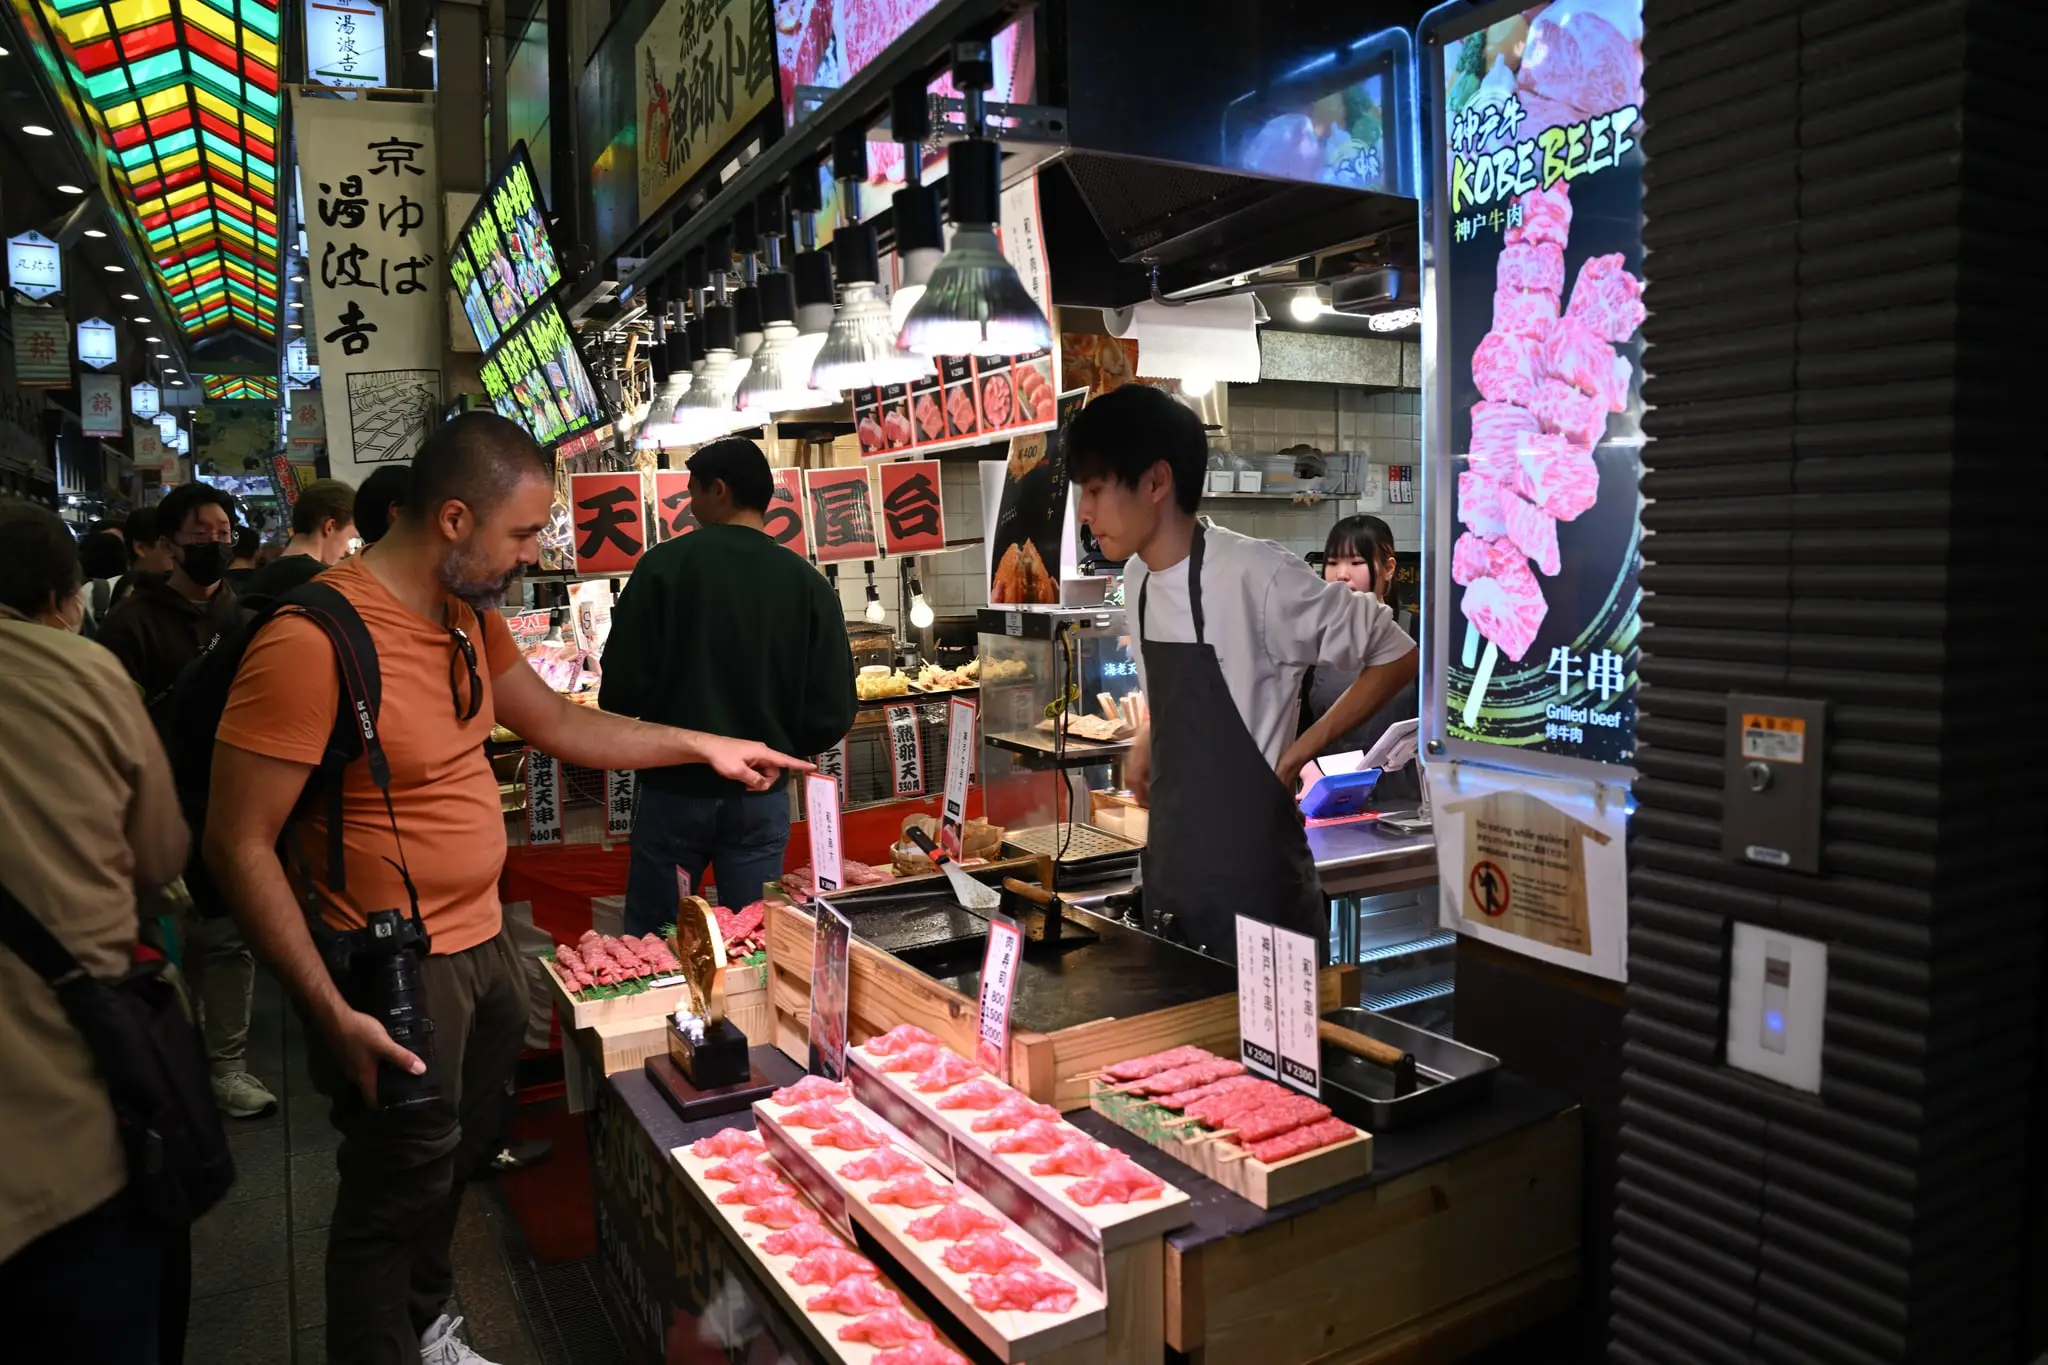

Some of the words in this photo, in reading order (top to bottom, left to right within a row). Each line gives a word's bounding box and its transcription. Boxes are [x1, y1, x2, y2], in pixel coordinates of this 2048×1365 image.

[335, 14, 360, 73] 湯波吉
[1453, 95, 1526, 151] 神戸牛
[1453, 139, 1538, 214] KOBE
[1538, 105, 1640, 191] BEEF
[367, 136, 434, 296] 京ゆば
[318, 174, 380, 356] 湯波吉
[1545, 645, 1625, 700] 牛串
[357, 700, 365, 711] R
[1546, 703, 1588, 724] Grilled
[1590, 708, 1621, 728] beef
[360, 711, 374, 740] EOS
[1545, 722, 1583, 743] 烤牛肉
[898, 779, 920, 792] 330円
[991, 990, 1005, 1007] 800
[1246, 1044, 1273, 1067] ¥2500
[1285, 1060, 1315, 1083] ¥2300
